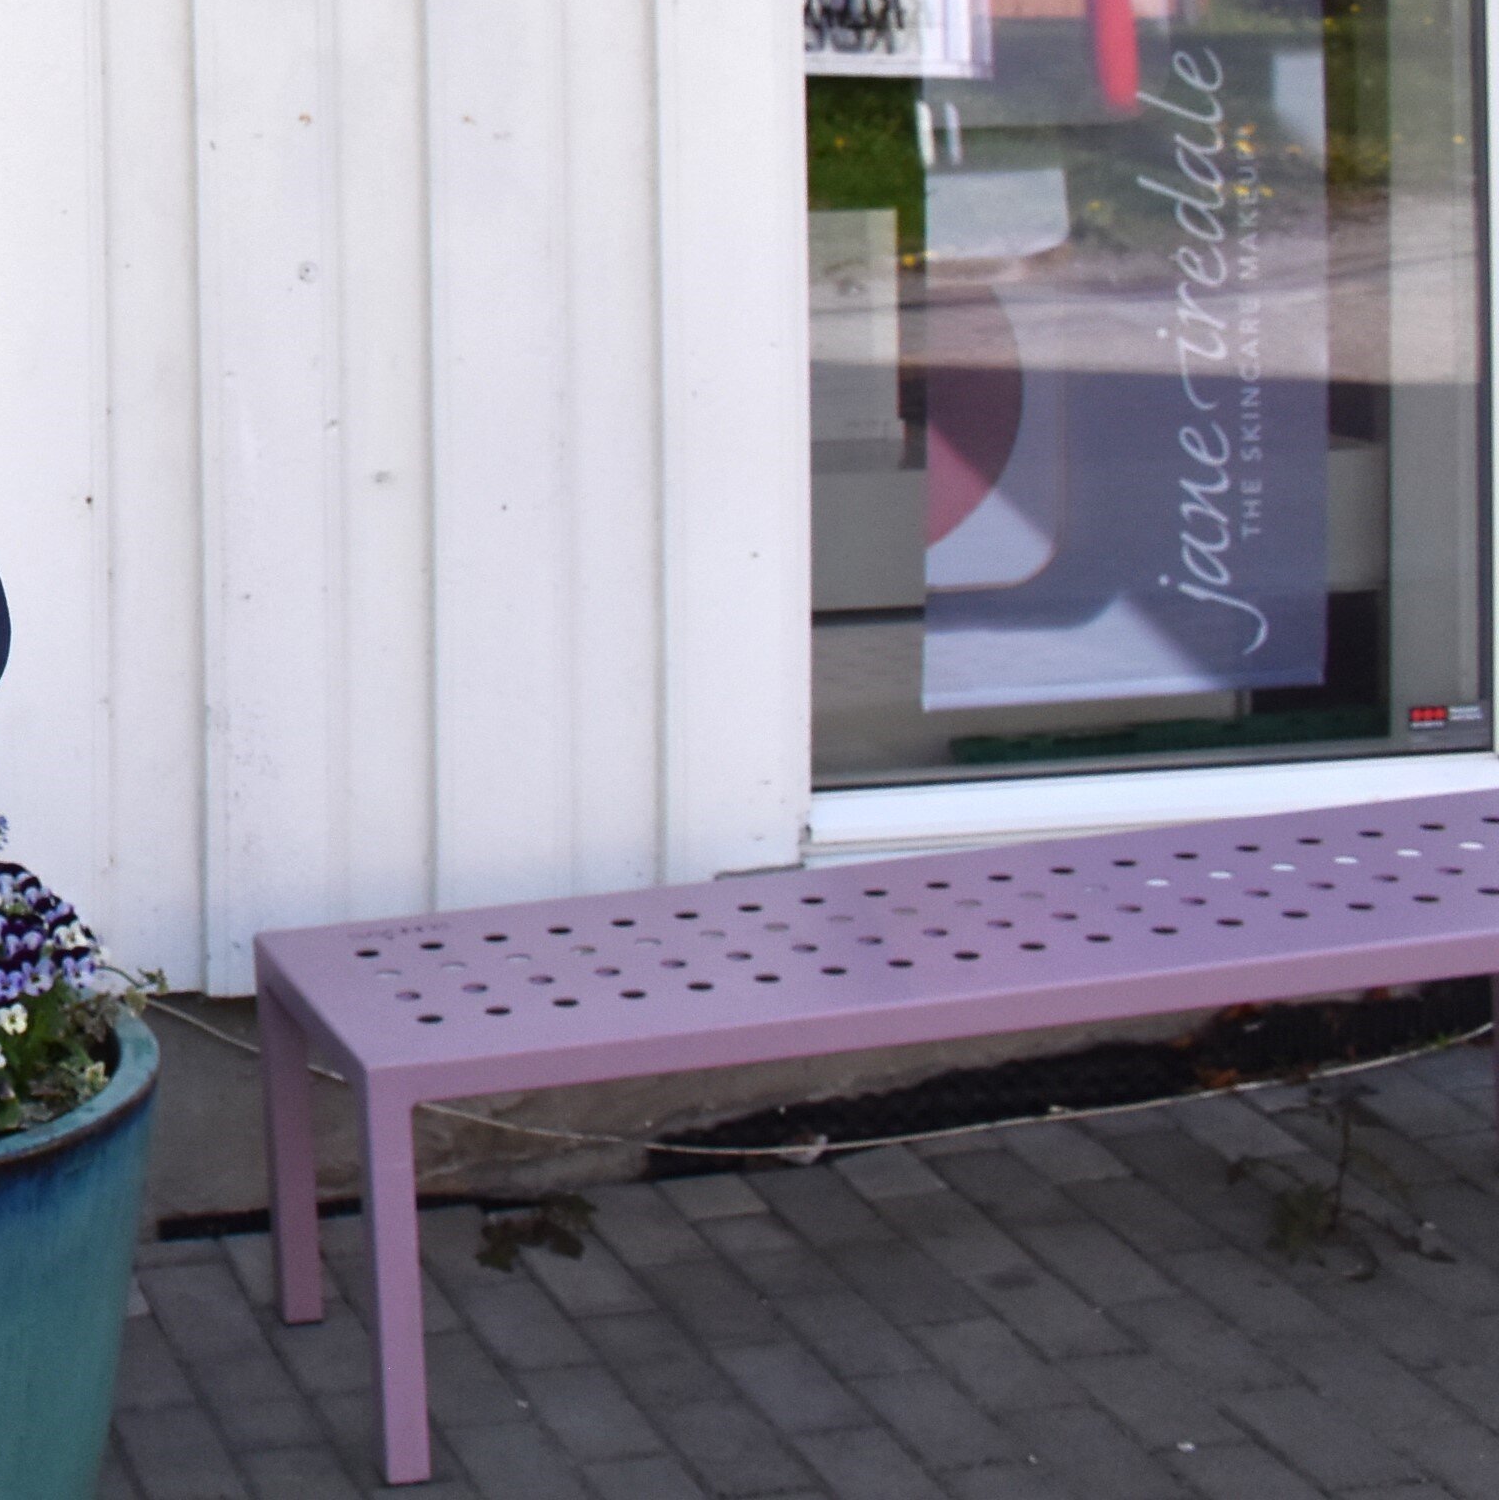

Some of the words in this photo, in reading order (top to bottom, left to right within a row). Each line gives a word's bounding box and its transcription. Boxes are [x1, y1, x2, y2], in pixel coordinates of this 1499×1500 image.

[1136, 46, 1229, 411] iredale
[1239, 298, 1263, 462] SKINCARE
[1158, 422, 1268, 655] jane
[1242, 480, 1263, 539] THE
